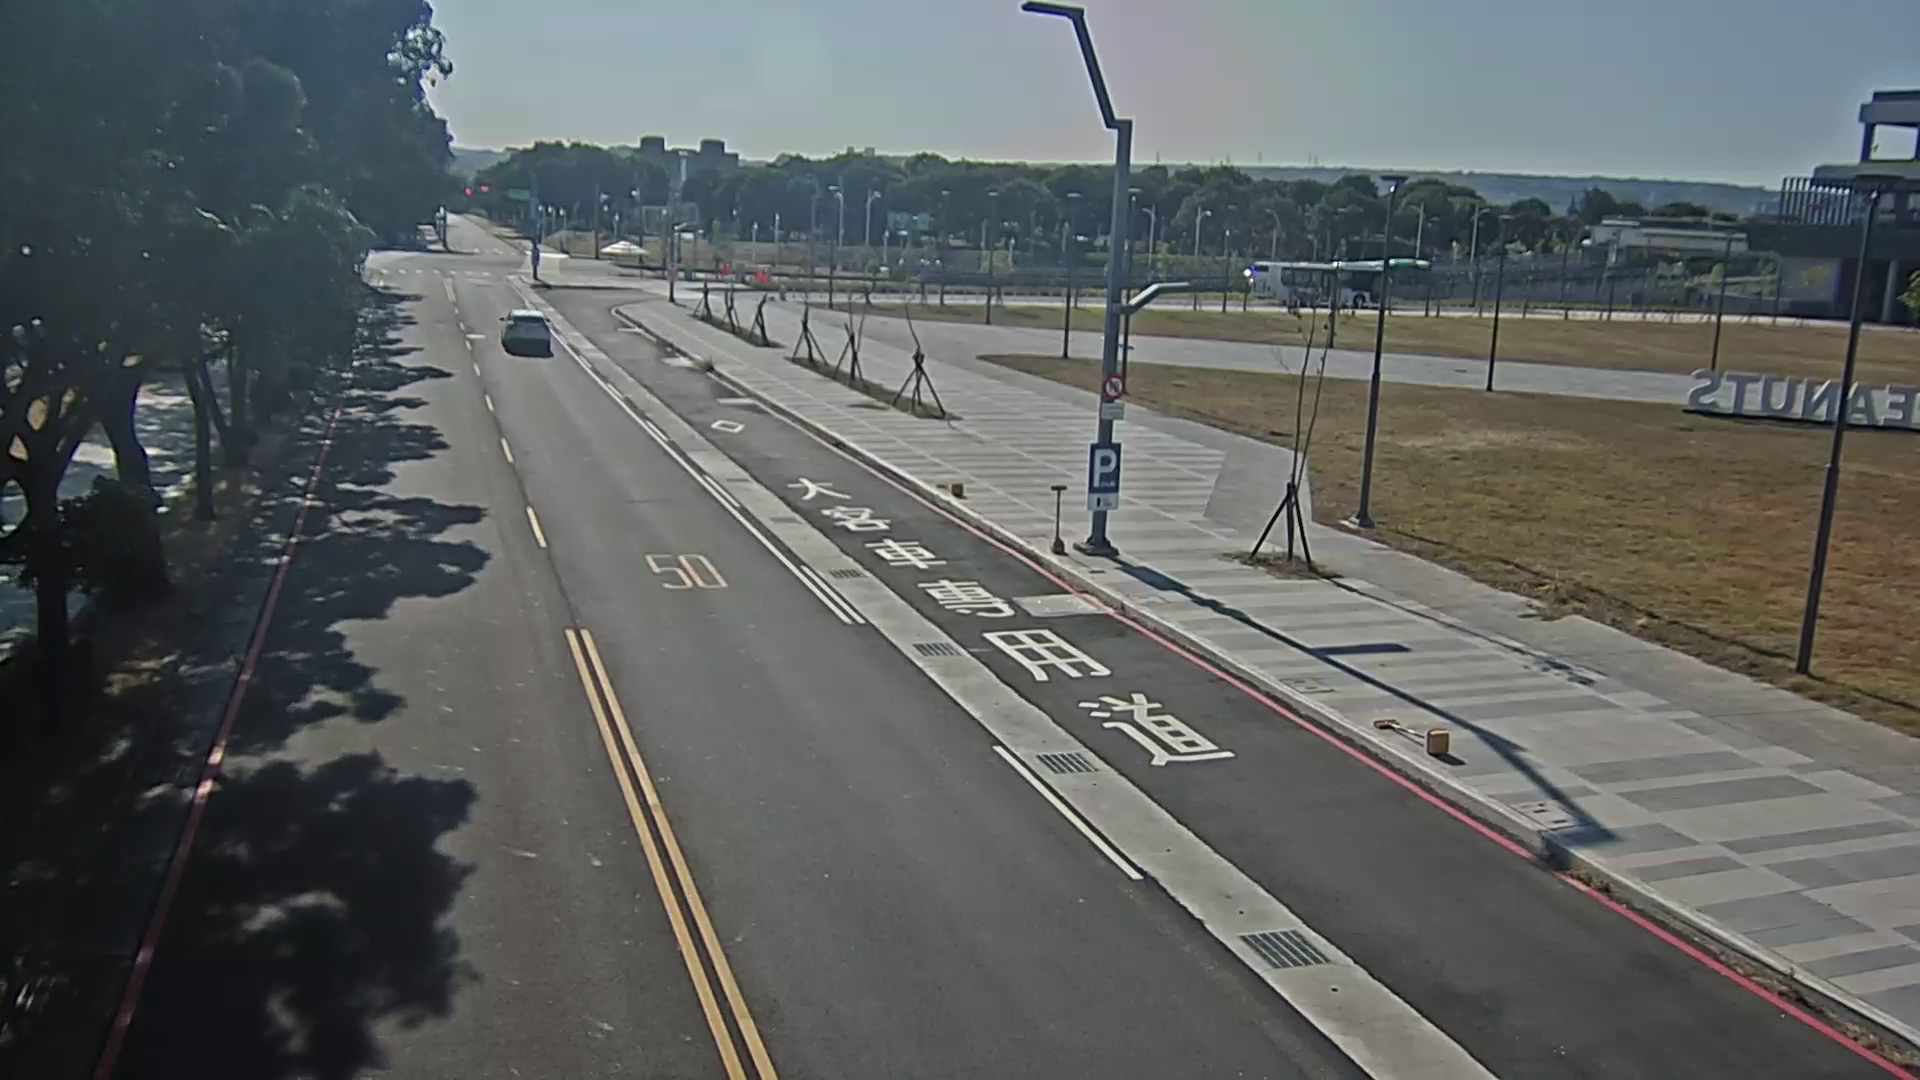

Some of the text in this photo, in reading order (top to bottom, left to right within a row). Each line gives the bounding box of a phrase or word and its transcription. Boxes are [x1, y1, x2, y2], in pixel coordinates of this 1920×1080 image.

[1093, 448, 1117, 488] P
[645, 553, 728, 589] 50
[786, 477, 1236, 767] 大客車專用道
